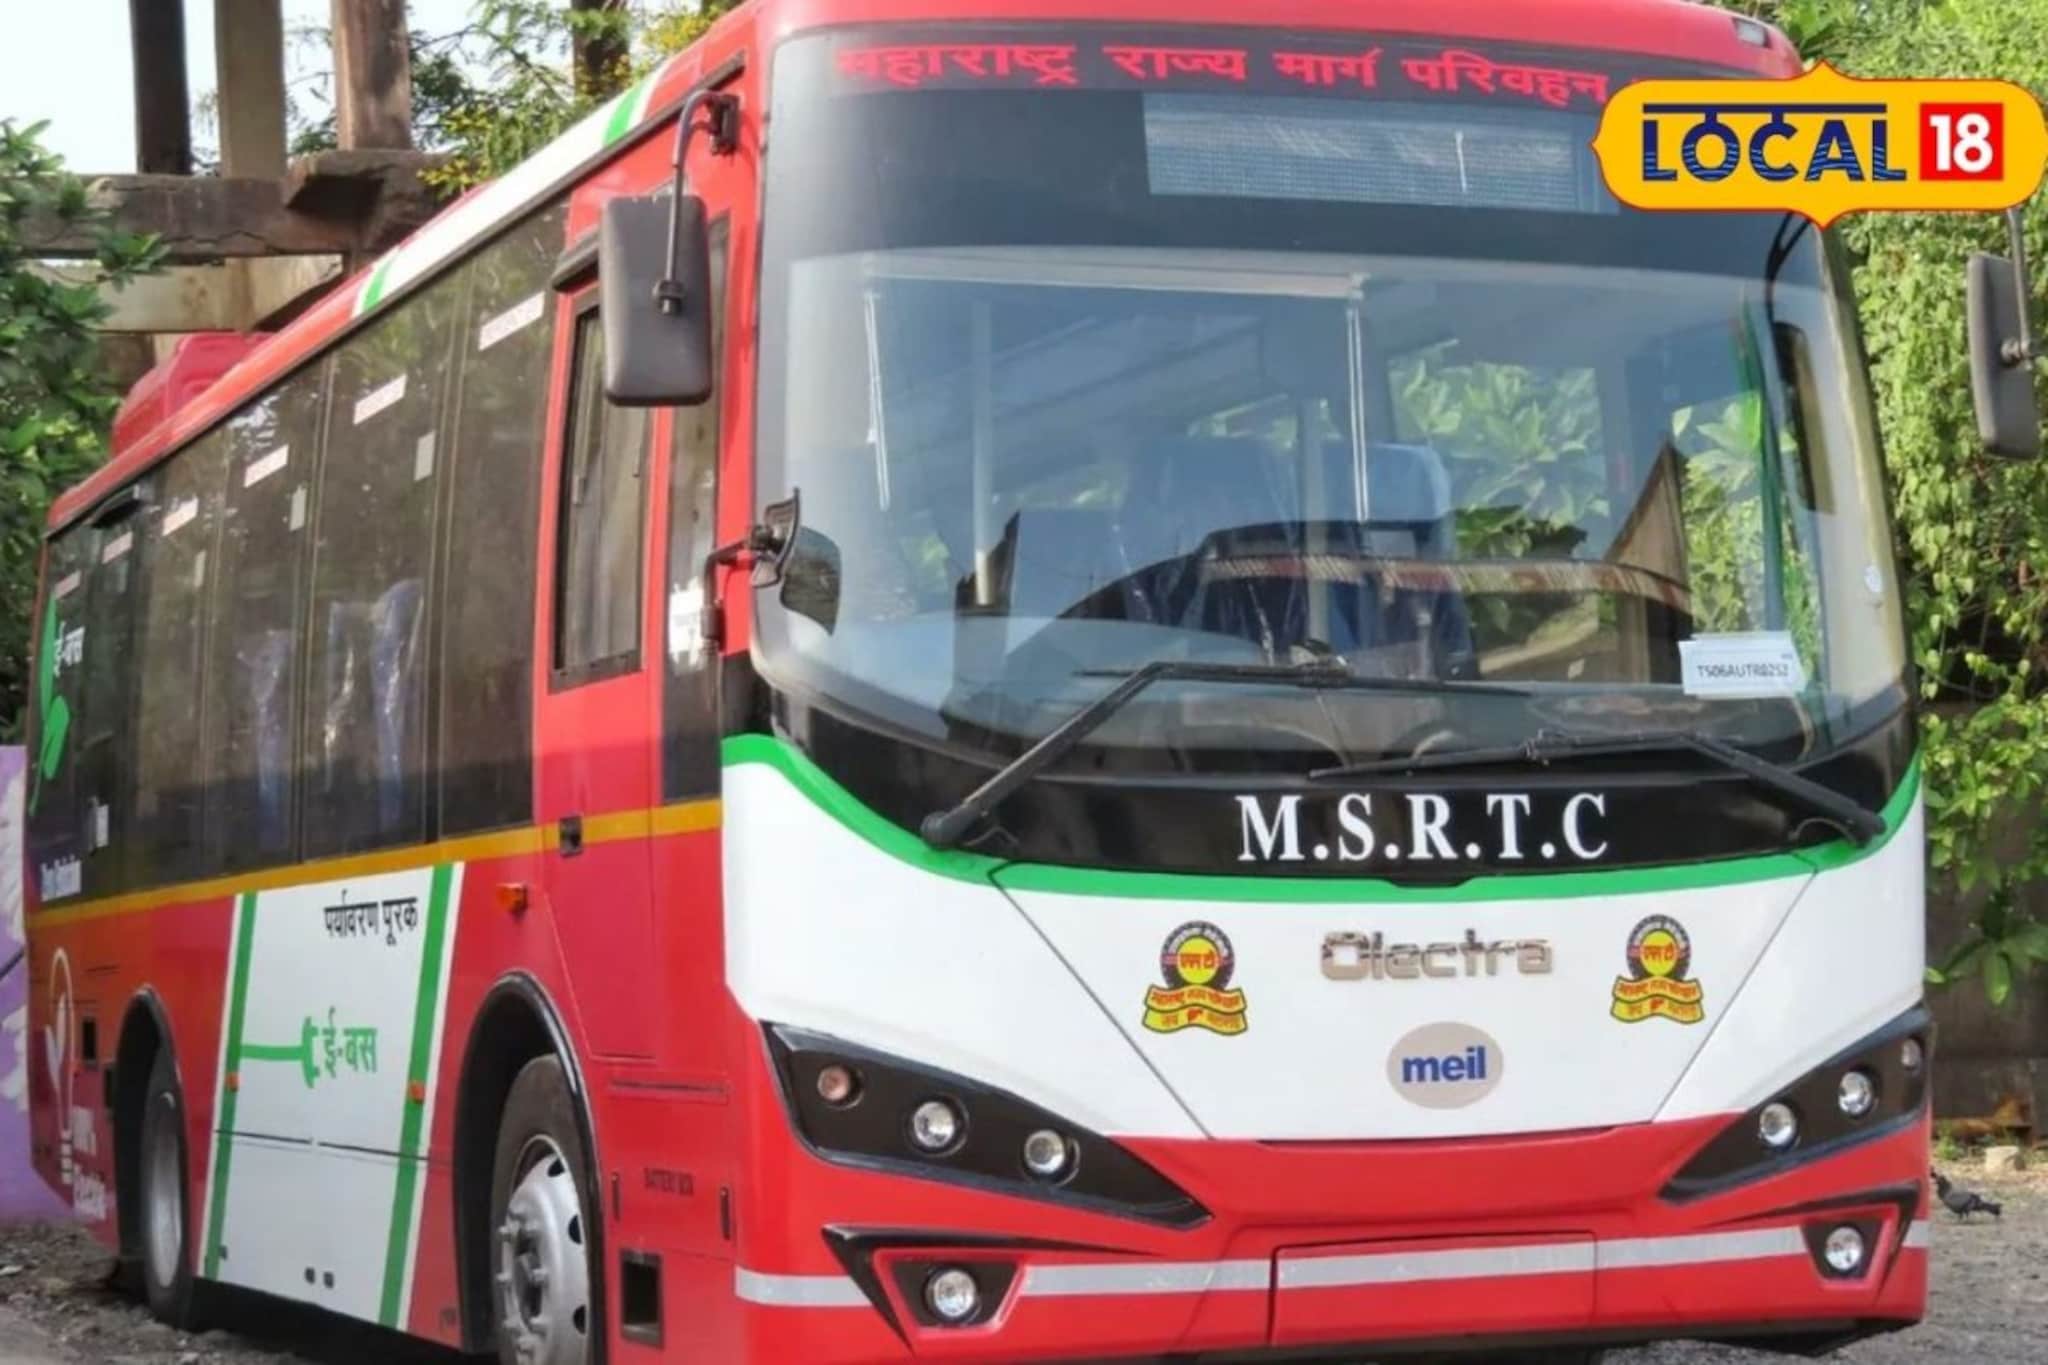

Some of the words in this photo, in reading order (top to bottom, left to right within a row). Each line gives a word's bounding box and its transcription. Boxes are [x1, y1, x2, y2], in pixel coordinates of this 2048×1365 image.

[836, 43, 1078, 86] महाराष्ट्र
[1102, 45, 1248, 81] राज्य
[1273, 48, 1384, 88] मार्ग
[1401, 49, 1609, 107] परिवहन
[1235, 792, 1608, 861] M.S.R.T.C
[381, 897, 418, 946] पूरक
[1320, 928, 1553, 982] Olectra
[1402, 1045, 1486, 1083] meil
